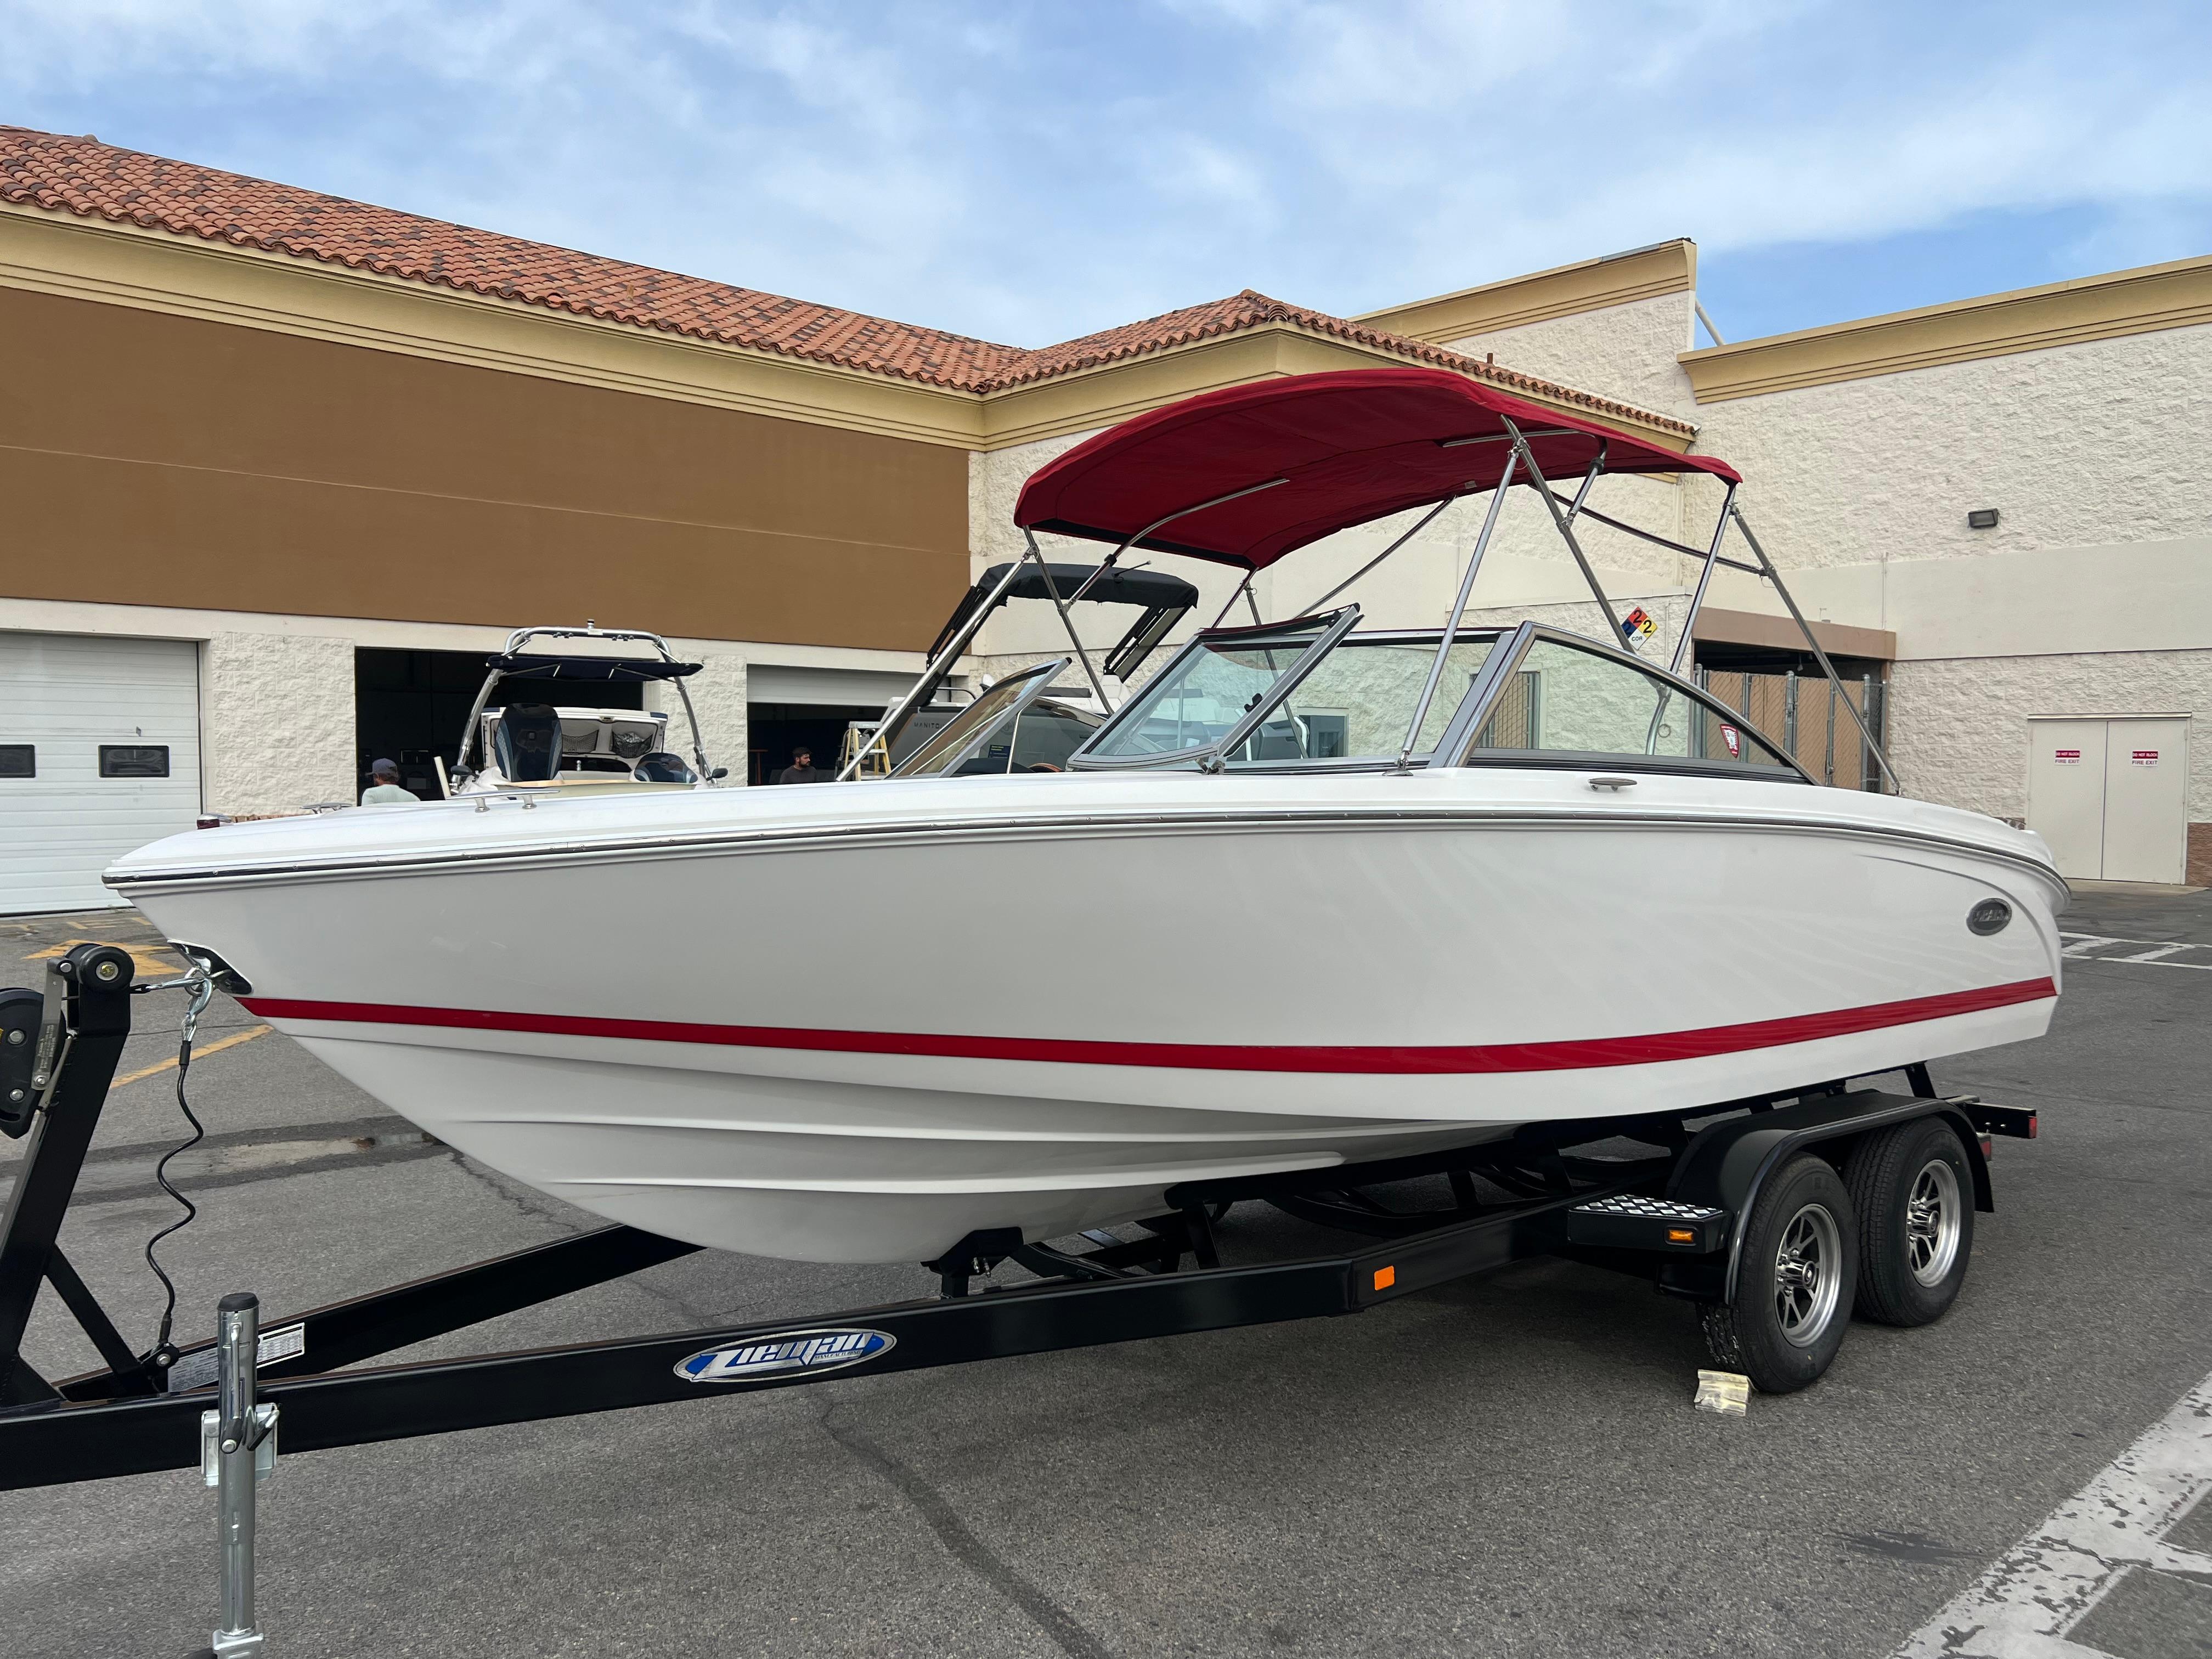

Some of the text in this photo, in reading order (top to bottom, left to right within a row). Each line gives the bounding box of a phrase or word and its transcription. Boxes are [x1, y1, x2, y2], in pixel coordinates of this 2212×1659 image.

[1633, 610, 1642, 624] 2
[1623, 619, 1652, 636] 2 2
